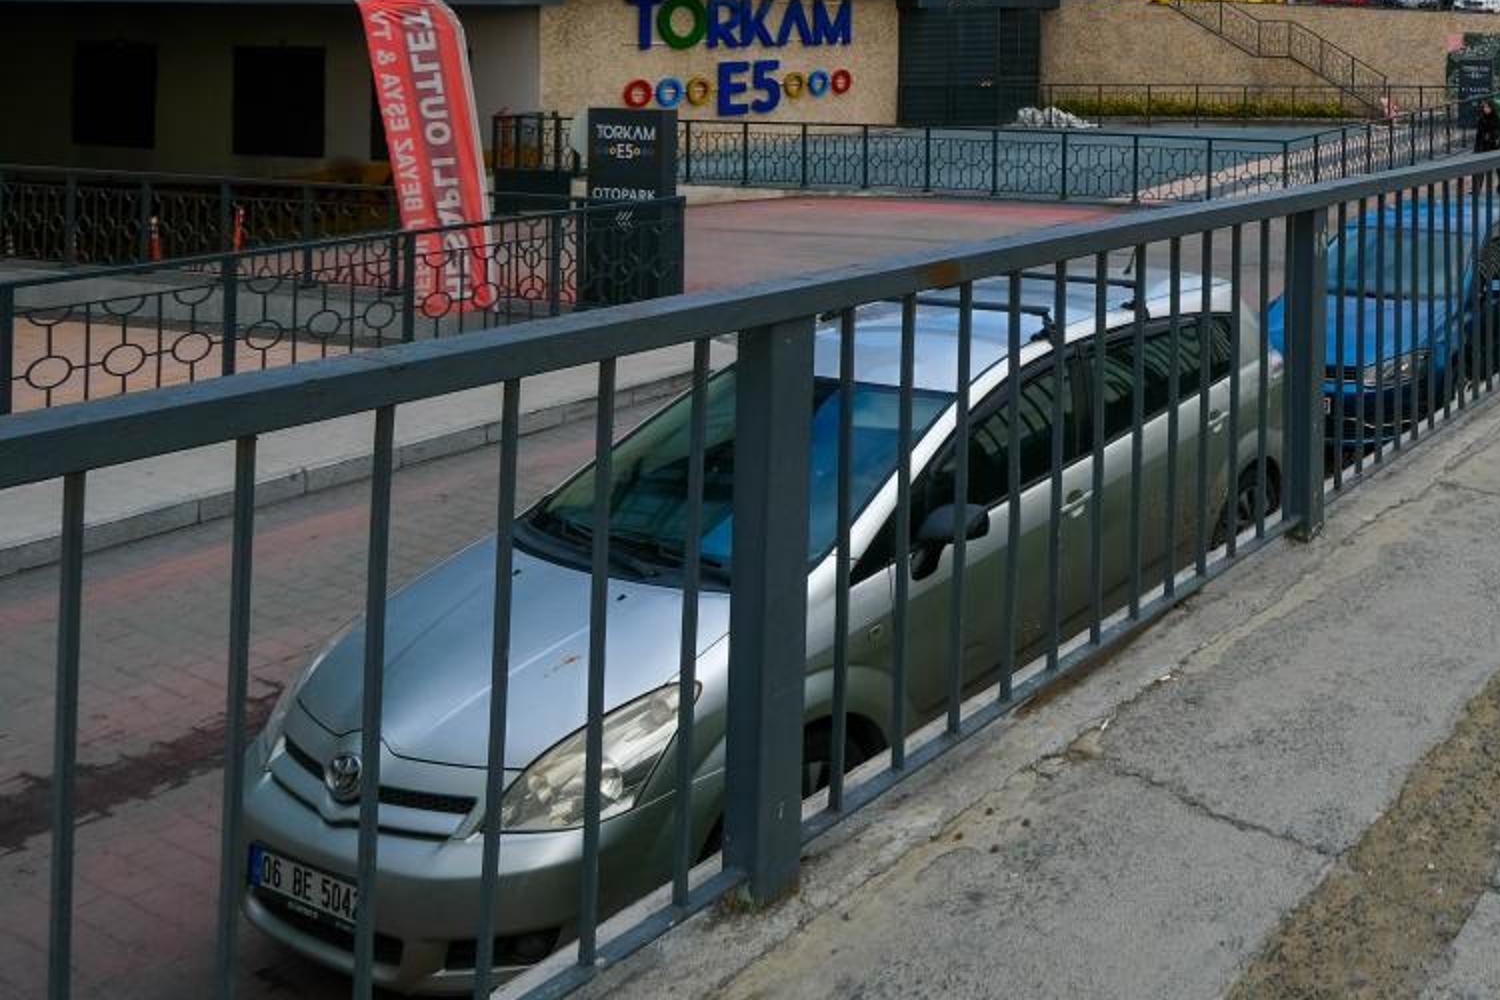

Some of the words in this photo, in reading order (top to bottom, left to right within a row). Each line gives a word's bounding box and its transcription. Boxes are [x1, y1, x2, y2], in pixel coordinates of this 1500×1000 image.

[595, 123, 657, 141] TORKAM
[592, 187, 656, 201] OTOPARK
[263, 855, 281, 889] 06
[293, 866, 313, 901] BE
